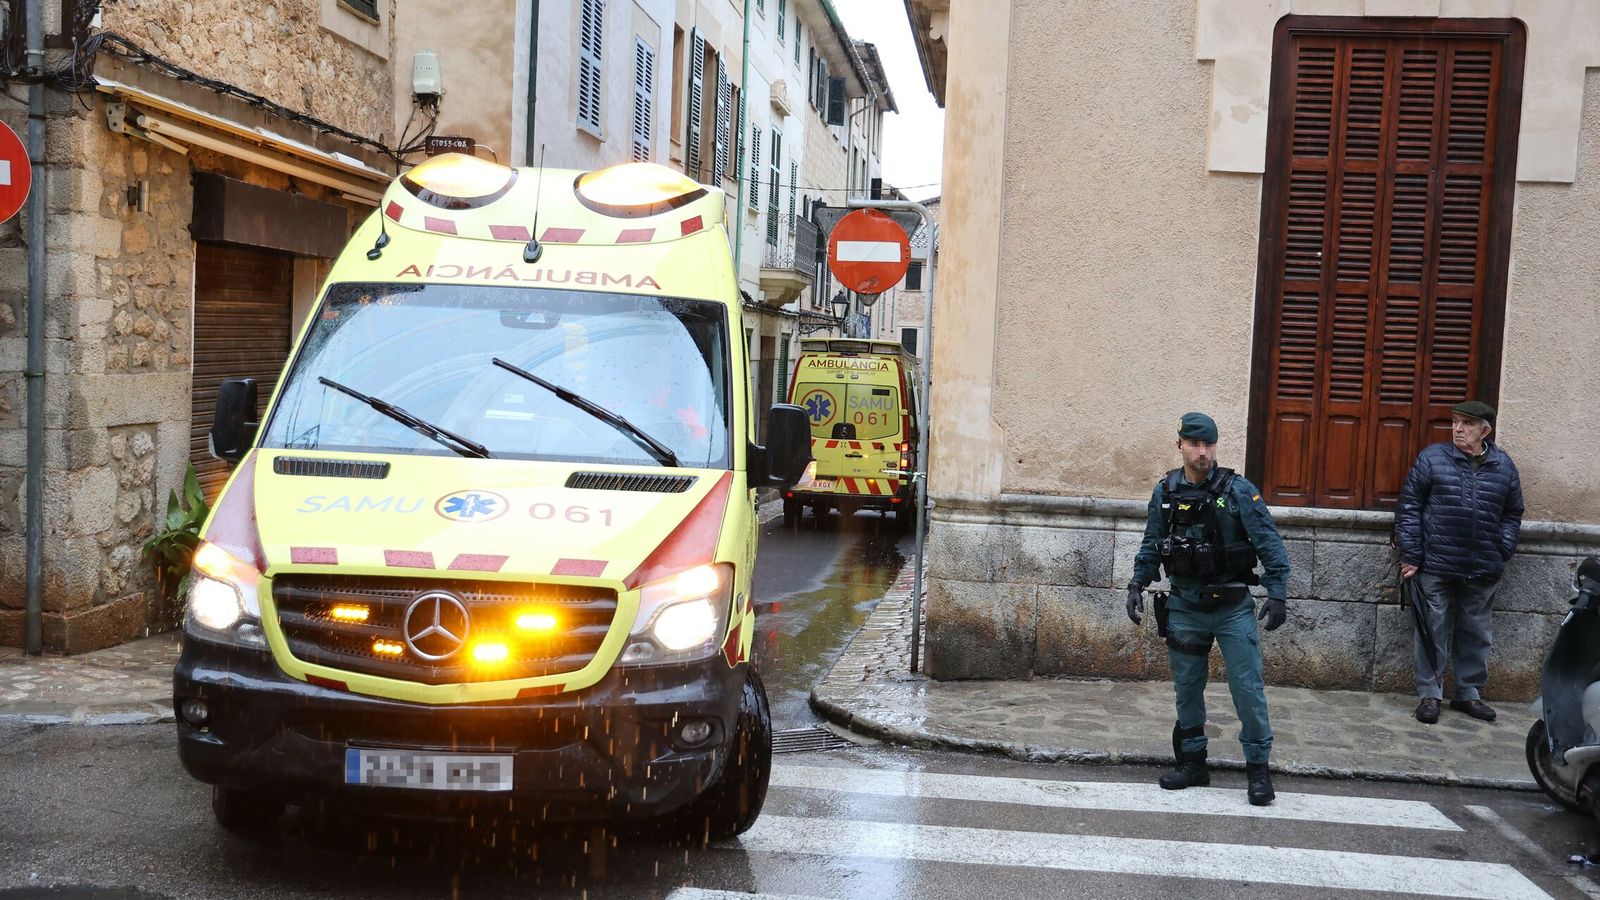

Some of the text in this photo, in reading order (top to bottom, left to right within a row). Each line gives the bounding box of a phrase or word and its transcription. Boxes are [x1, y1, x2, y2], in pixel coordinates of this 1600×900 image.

[850, 396, 894, 411] SAMU
[853, 411, 889, 426] 061
[296, 495, 613, 527] SAMU 061
